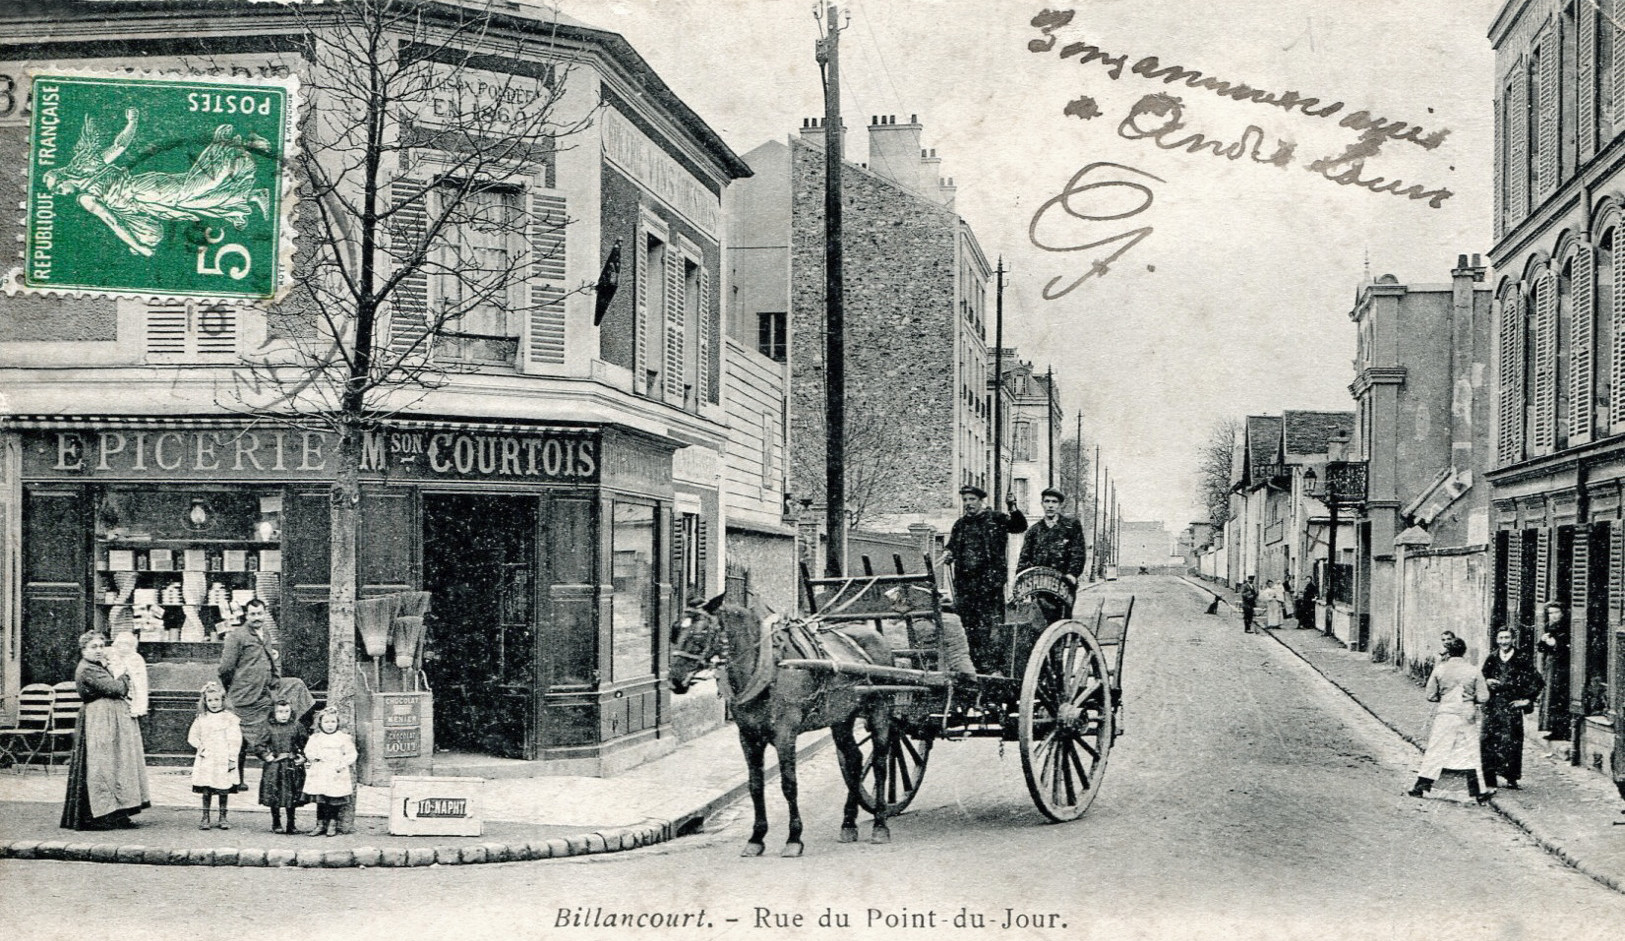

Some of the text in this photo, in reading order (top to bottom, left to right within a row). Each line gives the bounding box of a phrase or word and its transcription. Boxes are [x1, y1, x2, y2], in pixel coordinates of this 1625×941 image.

[39, 84, 60, 167] FRANÇAISE
[188, 92, 270, 116] POSTES
[52, 431, 328, 471] EPICERIE
[427, 433, 596, 477] COURTOIS
